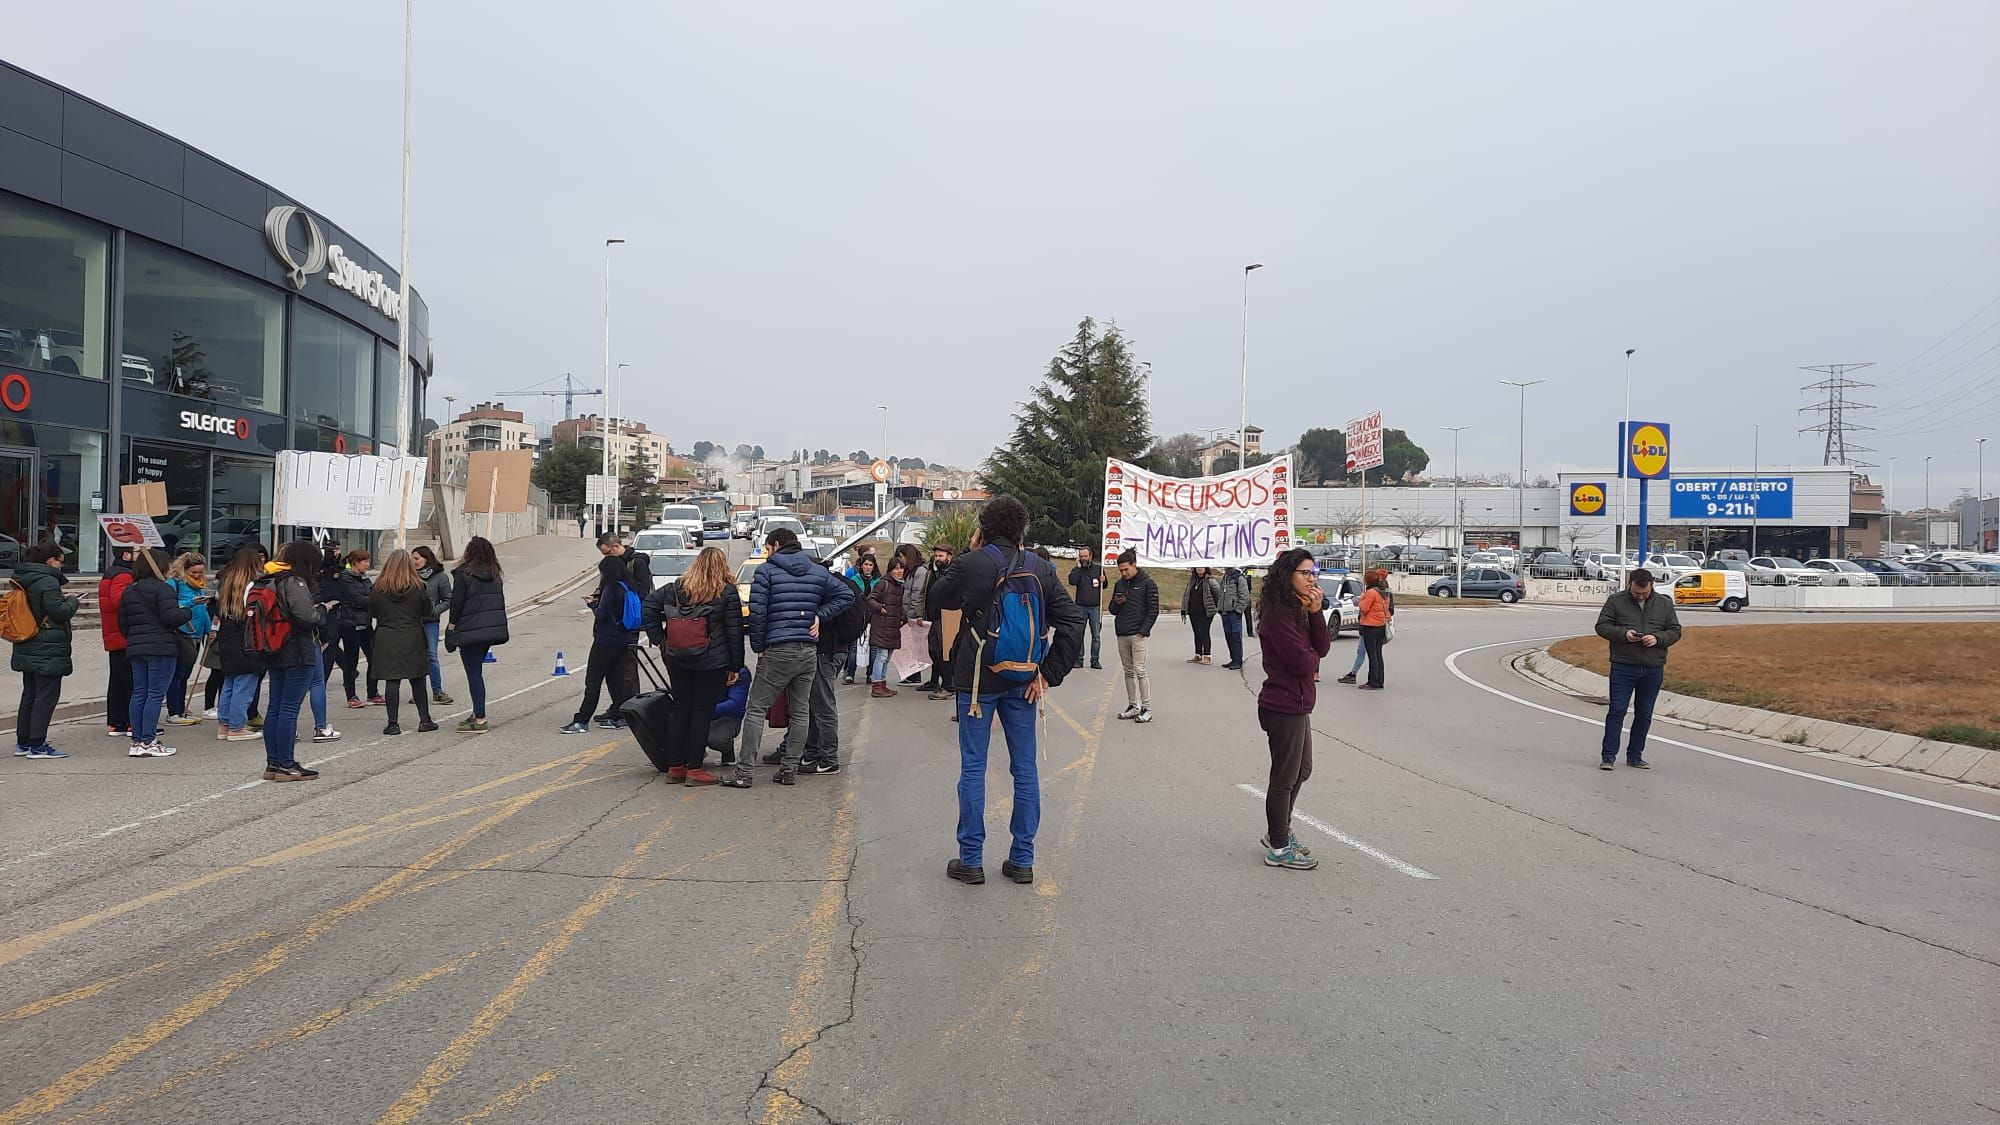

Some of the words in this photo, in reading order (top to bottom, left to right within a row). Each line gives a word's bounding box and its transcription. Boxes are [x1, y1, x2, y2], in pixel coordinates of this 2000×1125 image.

[138, 455, 149, 464] The
[150, 457, 168, 466] sound
[137, 466, 144, 475] of
[145, 467, 163, 477] happy
[1273, 472, 1287, 480] CGT
[1675, 482, 1718, 492] OBERT
[1729, 482, 1788, 492] ABIERTO
[1556, 582, 1573, 593] EL
[1578, 584, 1620, 595] CONSUM
